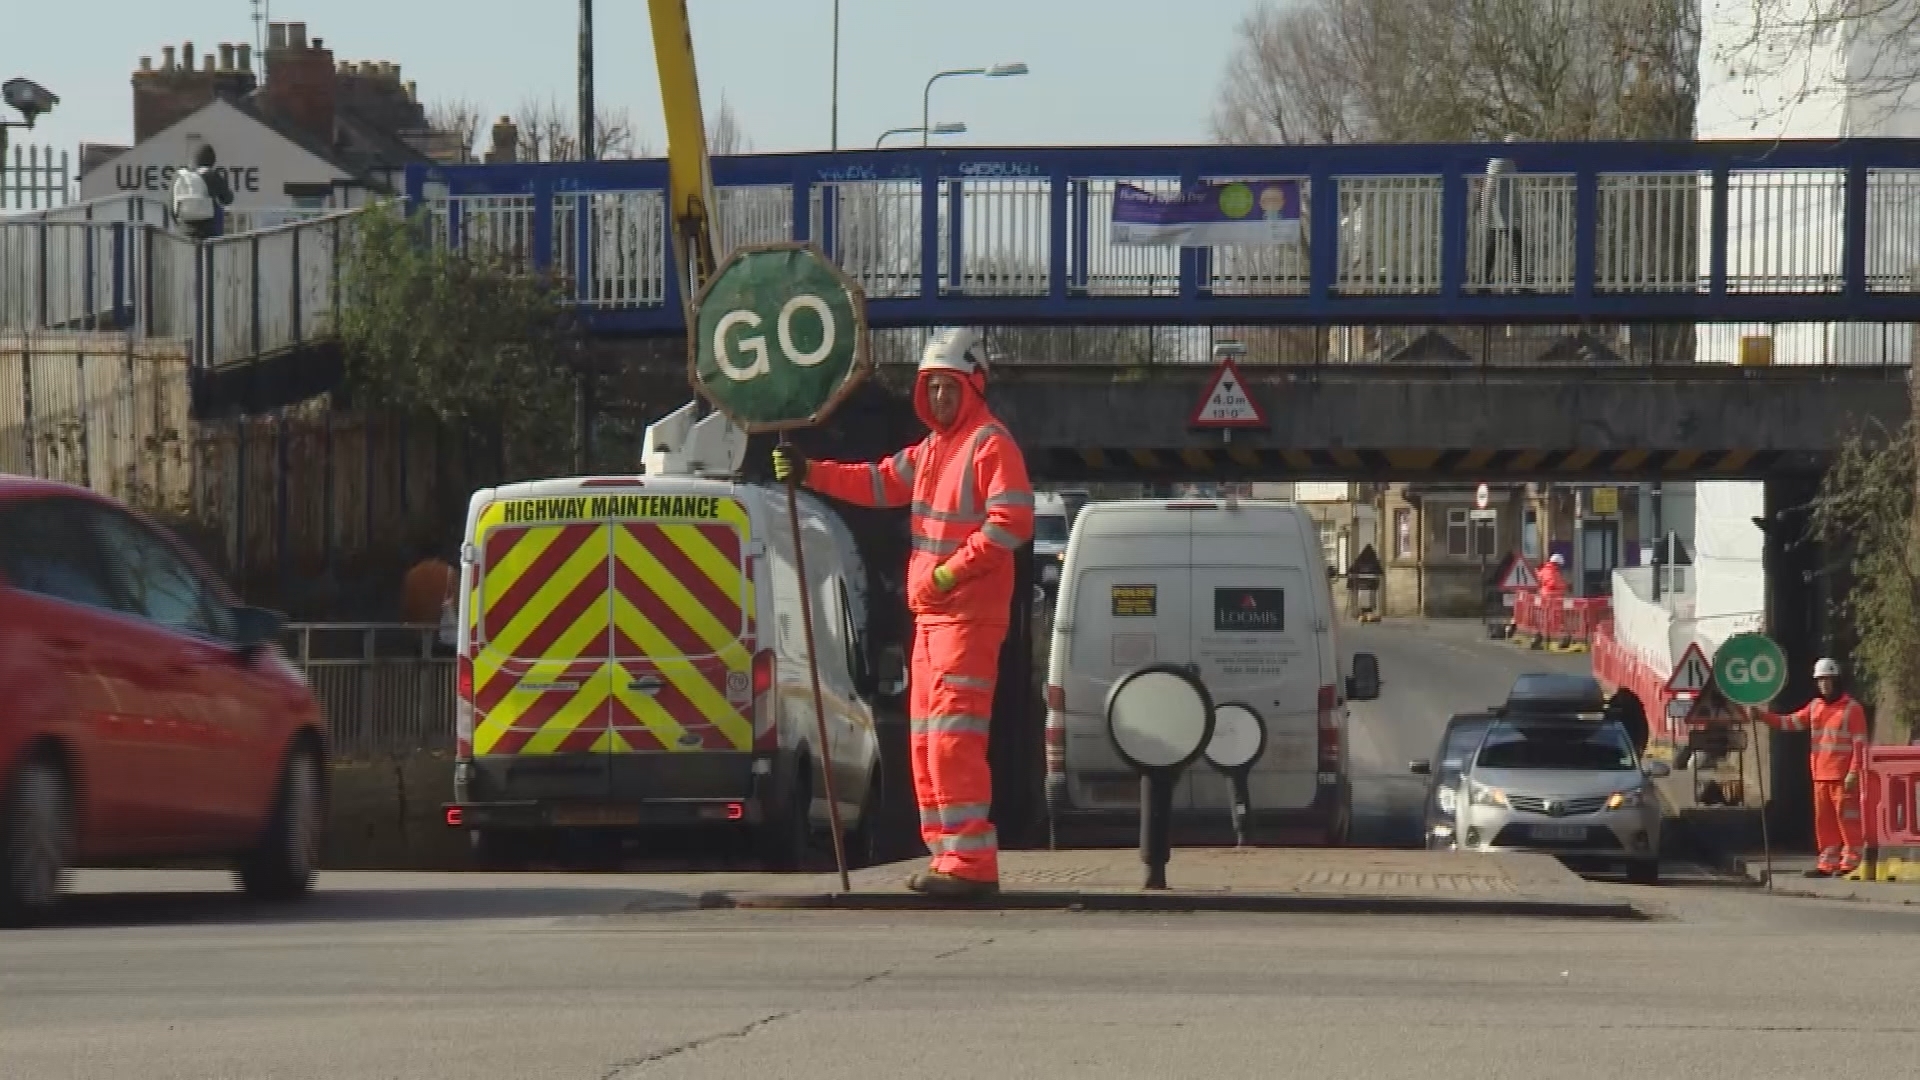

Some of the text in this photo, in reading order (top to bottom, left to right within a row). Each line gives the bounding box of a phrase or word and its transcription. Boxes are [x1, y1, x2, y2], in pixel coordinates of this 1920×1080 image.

[713, 294, 835, 380] GO
[504, 495, 719, 522] HIGHWAY MAINTENANCE
[1220, 609, 1278, 624] LOOMIS
[1725, 654, 1776, 685] GO
